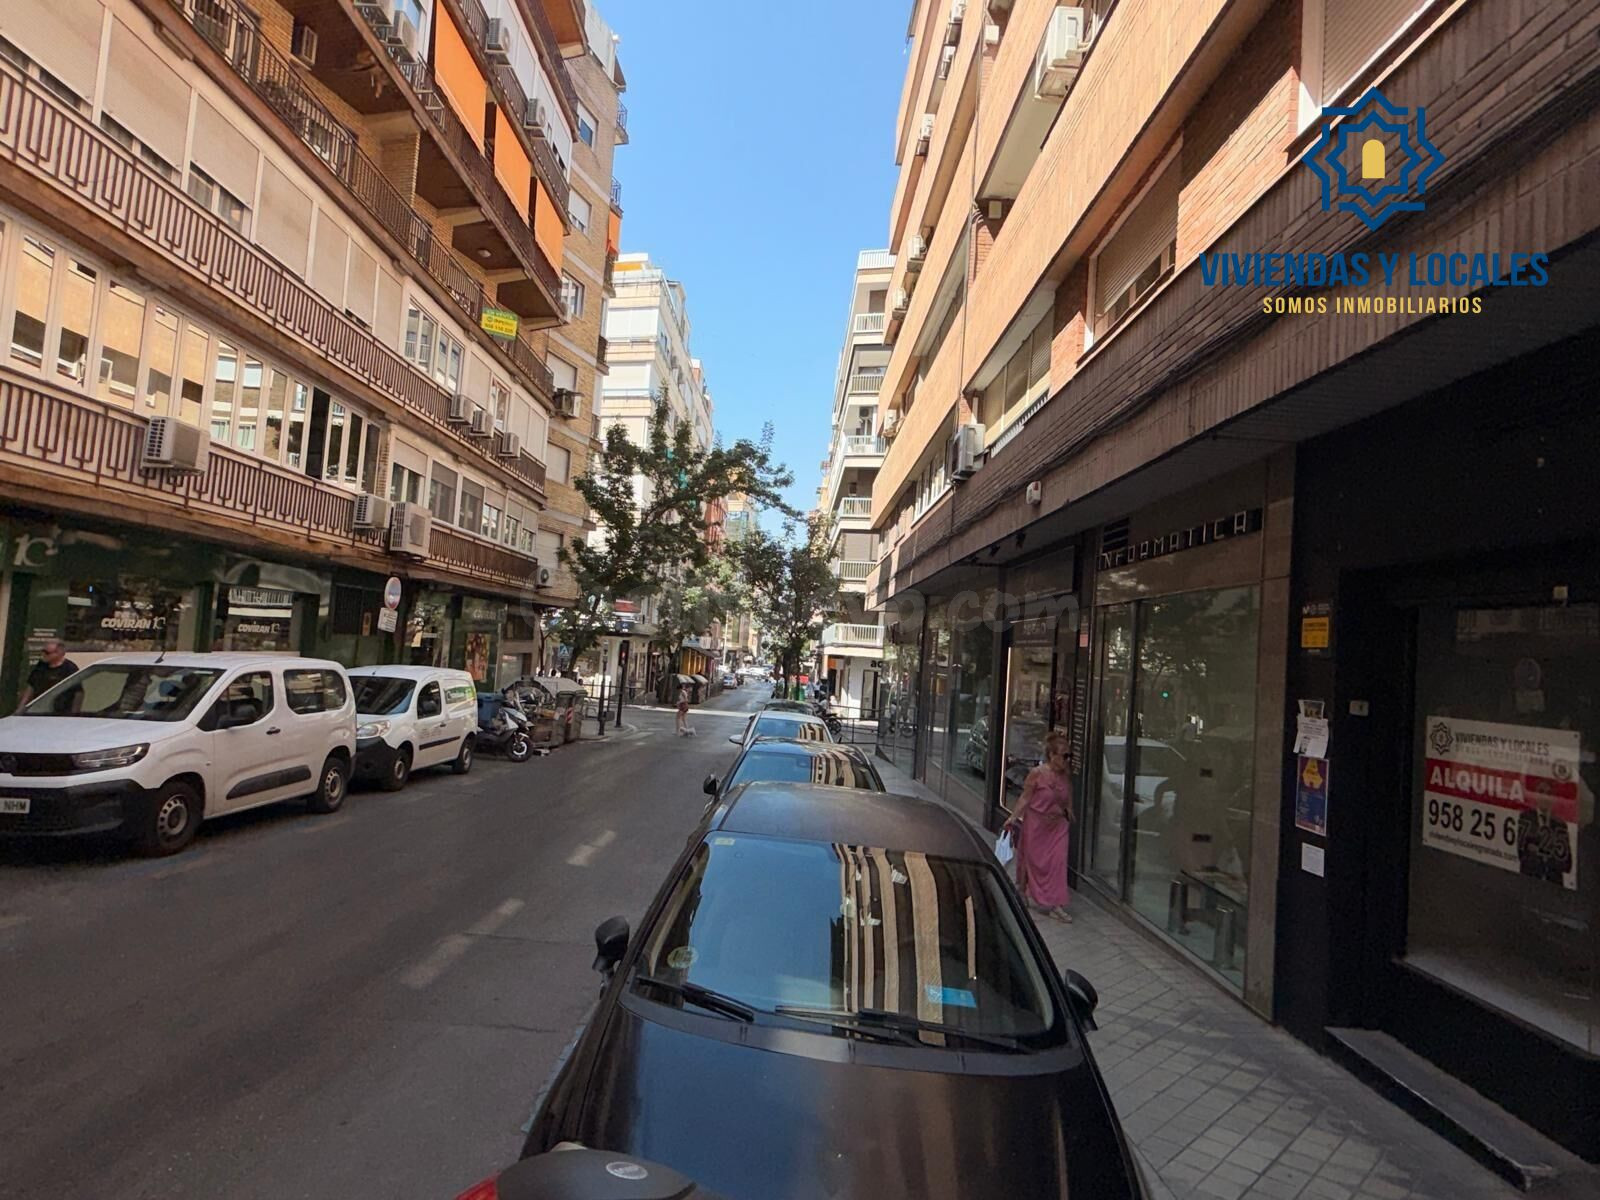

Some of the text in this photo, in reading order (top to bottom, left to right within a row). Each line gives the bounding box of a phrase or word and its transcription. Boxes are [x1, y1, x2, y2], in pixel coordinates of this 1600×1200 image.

[1098, 509, 1248, 571] INFORMATICA
[1455, 731, 1499, 749] VIVIENDAS
[1509, 738, 1550, 756] LOCALES
[1430, 765, 1525, 802] ALQUILA
[1428, 799, 1464, 832] 958
[1470, 809, 1496, 841] 25
